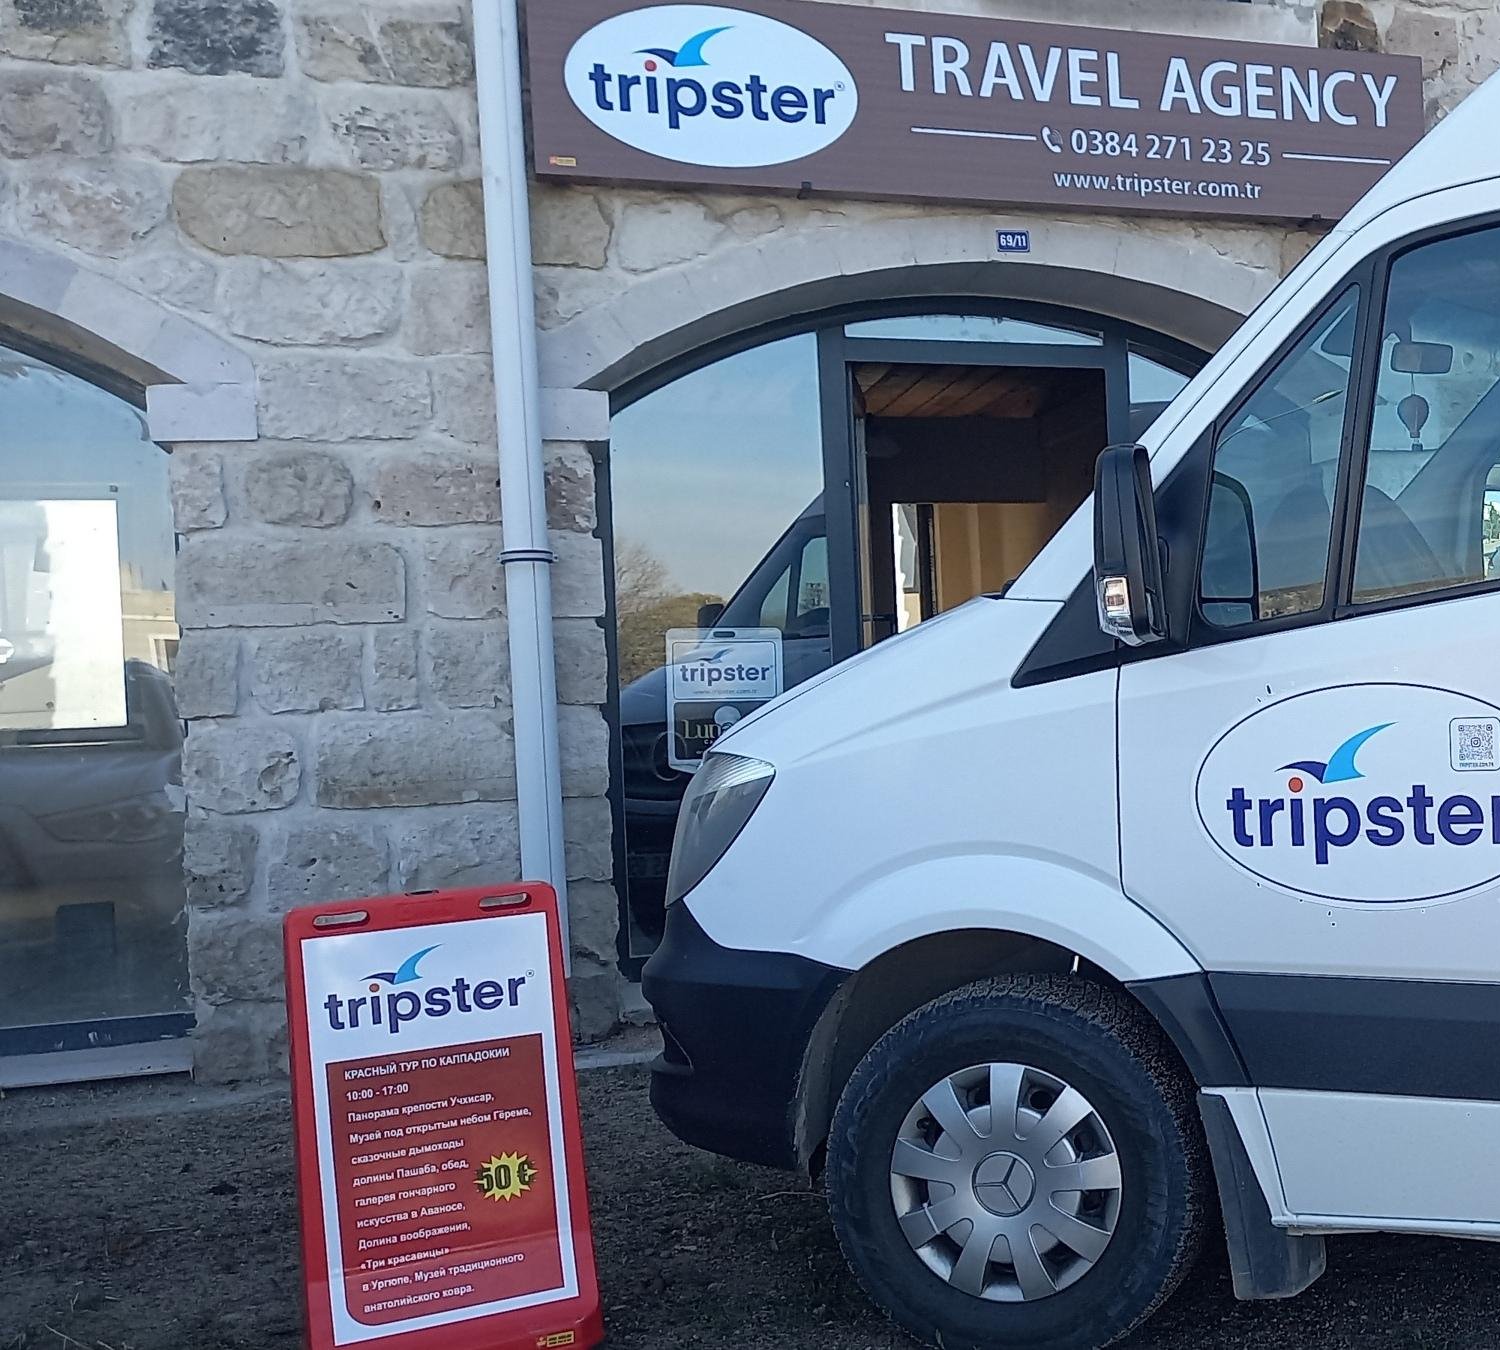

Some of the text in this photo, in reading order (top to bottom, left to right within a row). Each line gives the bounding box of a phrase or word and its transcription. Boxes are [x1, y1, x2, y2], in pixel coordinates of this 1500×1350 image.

[884, 32, 1398, 127] TRAVEL AGENCY
[1071, 128, 1271, 166] 0384 271 23 25
[1054, 171, 1262, 199] www.tripster.com.tr
[999, 233, 1027, 247] 69/11
[344, 1047, 510, 1080] КРАСНЫЙ ТУР ПО КАППАДОКИИ
[346, 1089, 373, 1101] 10:00
[381, 1083, 409, 1096] 17:00
[347, 1093, 495, 1123] Панорама крепости Учхисар,
[349, 1131, 382, 1145] Музей
[384, 1129, 404, 1139] под
[405, 1119, 458, 1136] открытым
[460, 1112, 491, 1126] небом
[351, 1138, 464, 1165] сказочные дымоходы
[353, 1172, 395, 1187] долины
[481, 1163, 511, 1192] 50
[355, 1182, 456, 1207] галерея гончарного
[356, 1213, 409, 1229] искусства
[358, 1235, 398, 1250] Долина
[414, 1268, 446, 1283] Музей
[447, 1252, 525, 1275] традиционного
[363, 1291, 440, 1314] анатолийского
